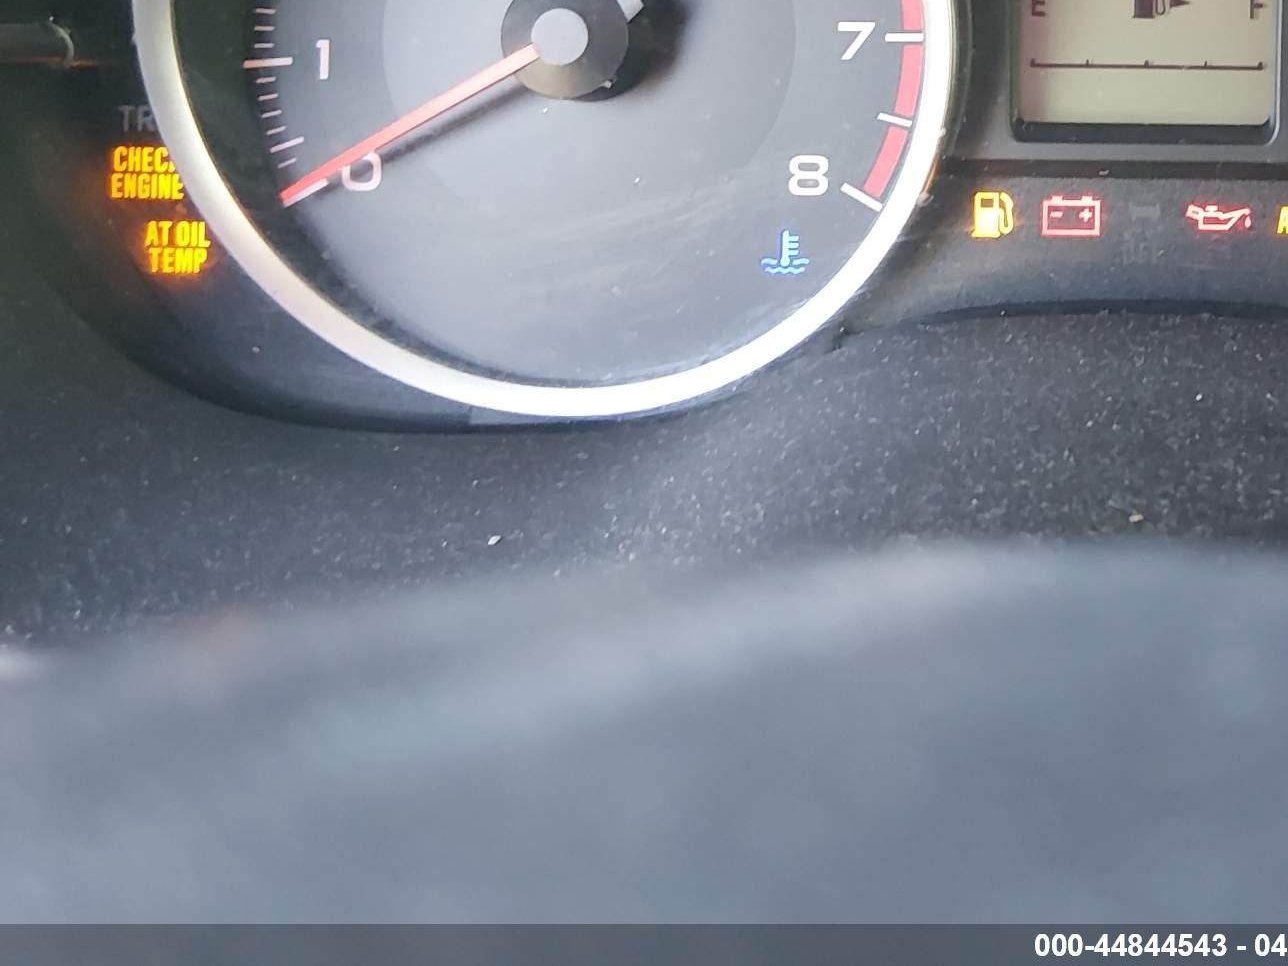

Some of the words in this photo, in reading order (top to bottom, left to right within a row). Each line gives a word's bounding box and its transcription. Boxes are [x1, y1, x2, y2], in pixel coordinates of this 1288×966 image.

[837, 21, 876, 61] 7
[315, 39, 331, 80] 1
[118, 104, 157, 132] TR
[111, 172, 185, 200] ENGINE
[787, 154, 830, 197] 8
[145, 221, 172, 247] AT
[176, 221, 211, 248] OIL
[148, 247, 208, 274] TEMP
